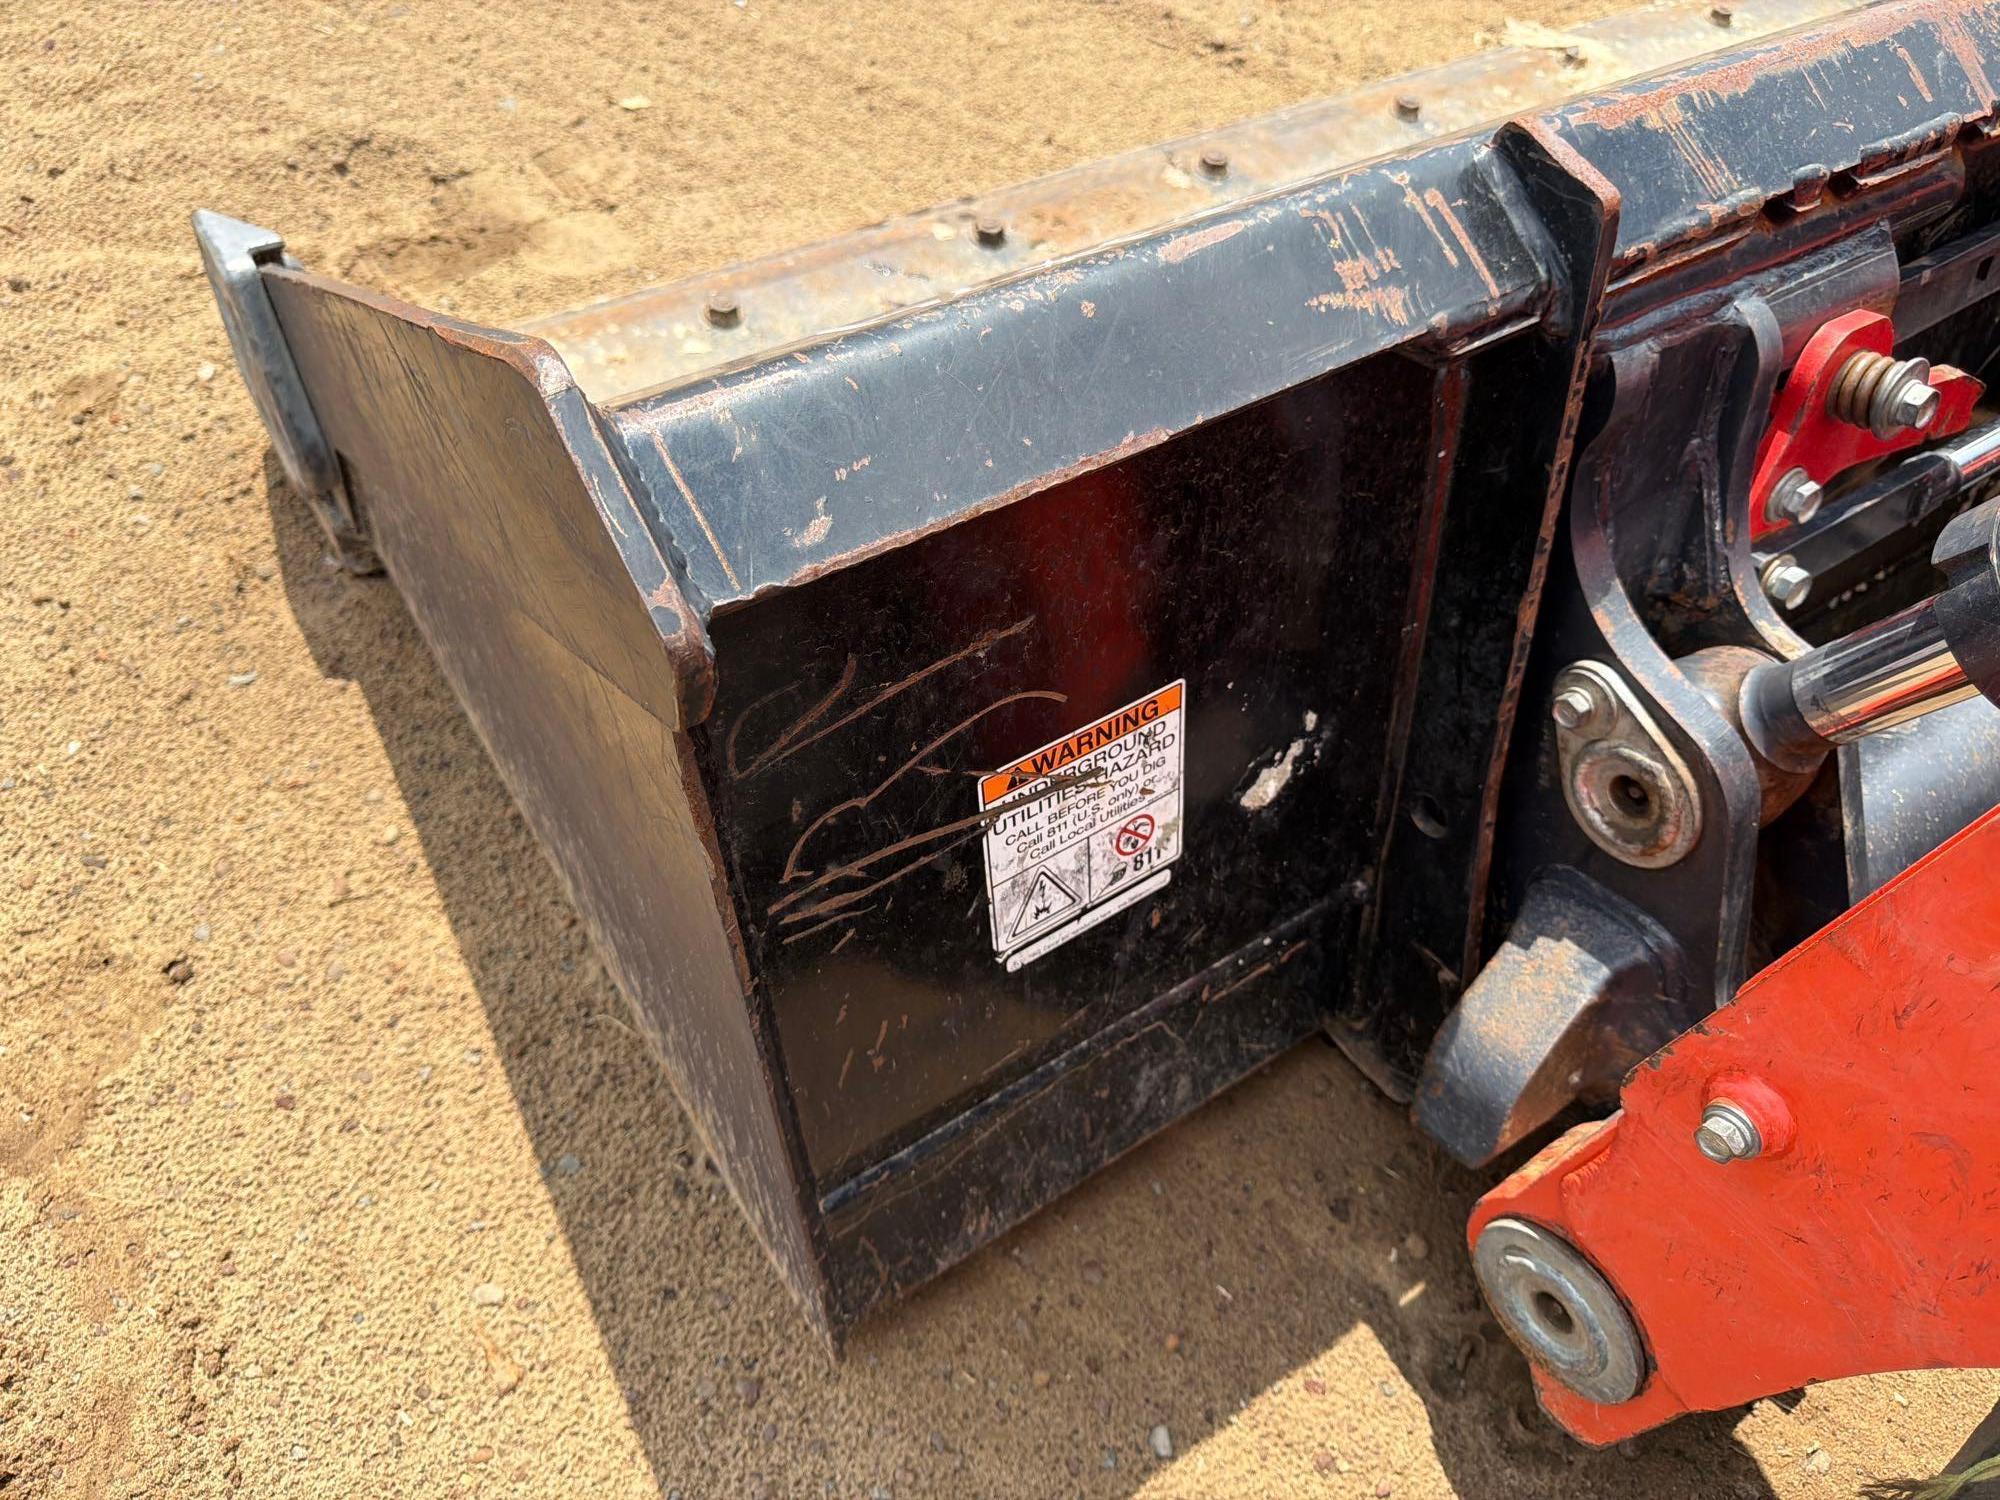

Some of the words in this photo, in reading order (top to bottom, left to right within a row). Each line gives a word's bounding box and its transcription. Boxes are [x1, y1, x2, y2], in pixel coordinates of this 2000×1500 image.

[1002, 721, 1166, 804] NDRGROUND
[1030, 699, 1159, 777] WARNING
[993, 783, 1087, 836] UTILITIES
[1095, 733, 1175, 784] HAZARD
[1005, 821, 1044, 846] CALL
[1047, 787, 1106, 825] BEFORE
[1109, 769, 1139, 792] YOU
[1142, 756, 1166, 775] DIG
[1016, 832, 1043, 854] Call
[1047, 821, 1068, 838] 811
[1072, 803, 1104, 827] (U.S.
[1108, 783, 1139, 806] only)
[1029, 838, 1056, 860] Call
[1059, 817, 1096, 845] Local
[1099, 795, 1146, 823] Utilities
[1133, 846, 1162, 872] 811
